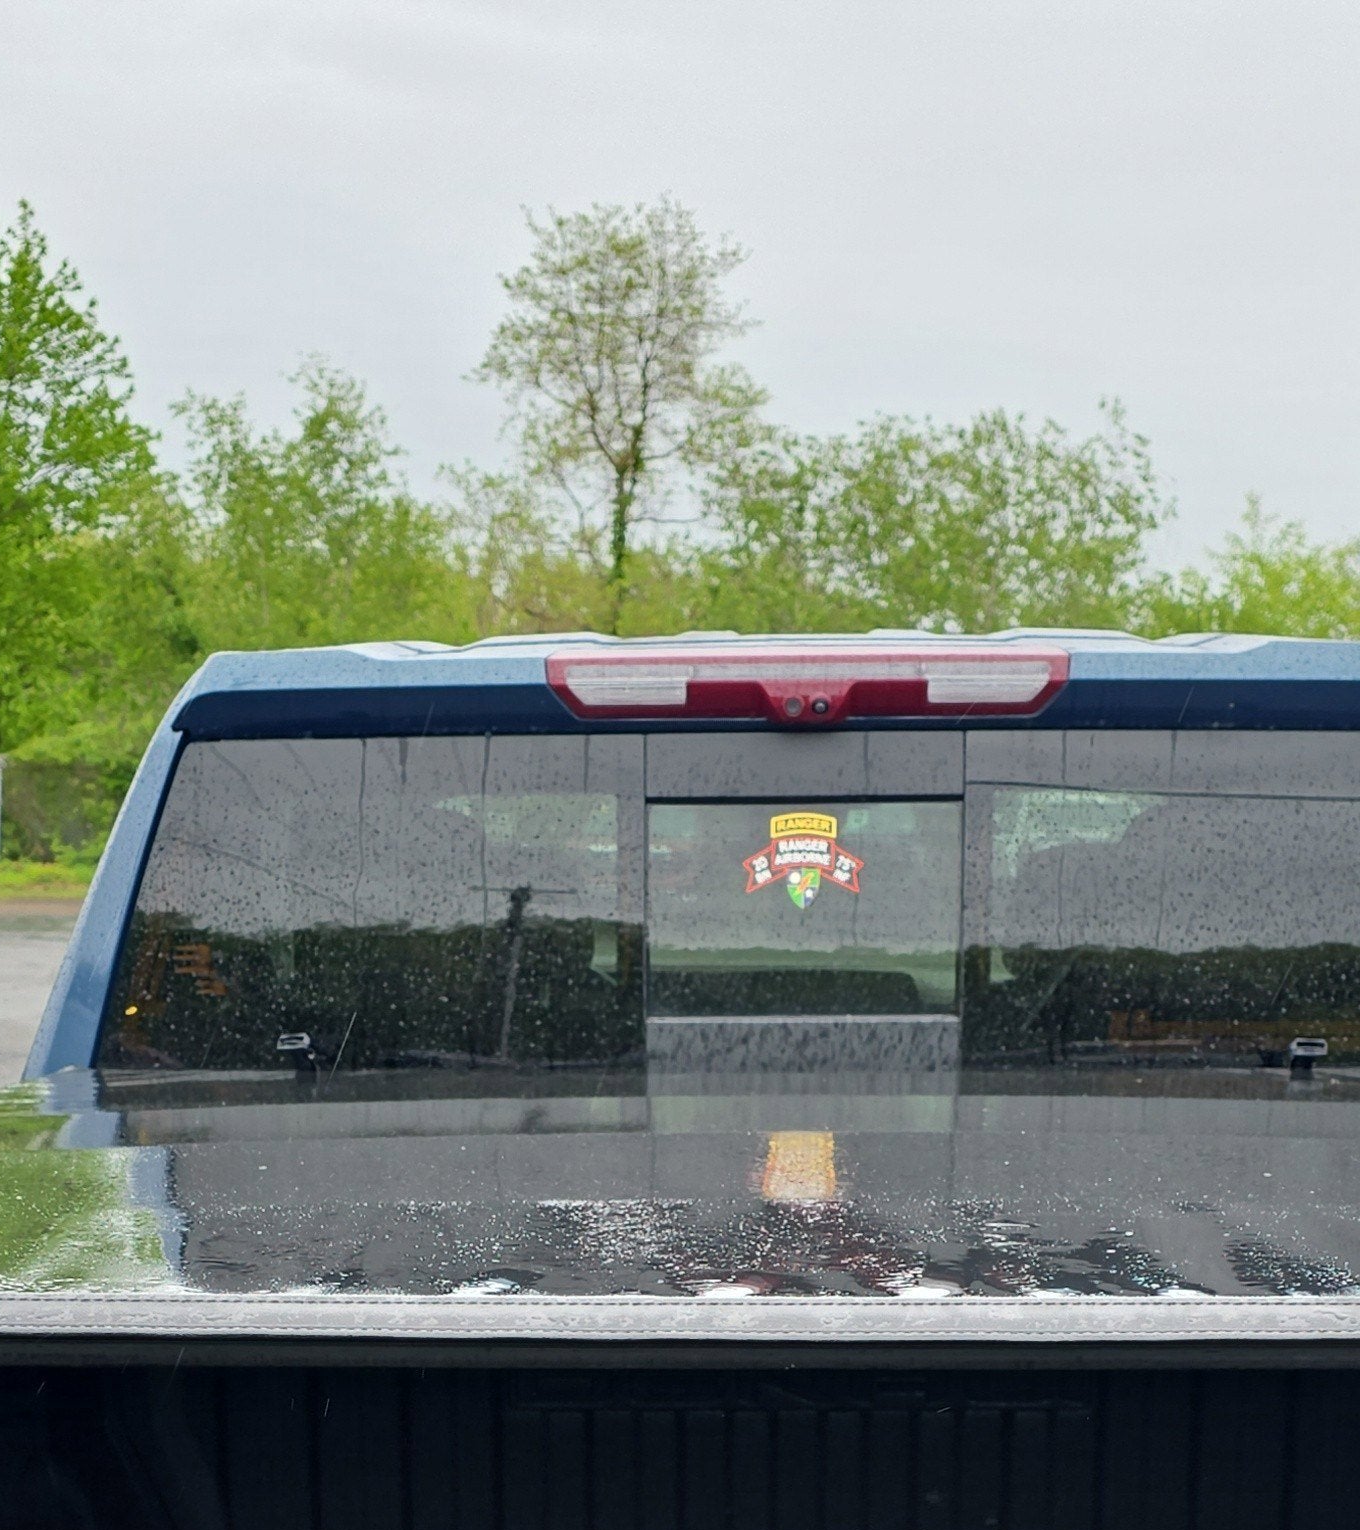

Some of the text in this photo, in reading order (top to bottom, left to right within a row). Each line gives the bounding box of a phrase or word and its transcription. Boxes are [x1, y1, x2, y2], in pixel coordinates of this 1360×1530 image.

[776, 818, 831, 833] RANGER
[778, 839, 829, 853] RANGER
[774, 852, 831, 866] AIRBORNE
